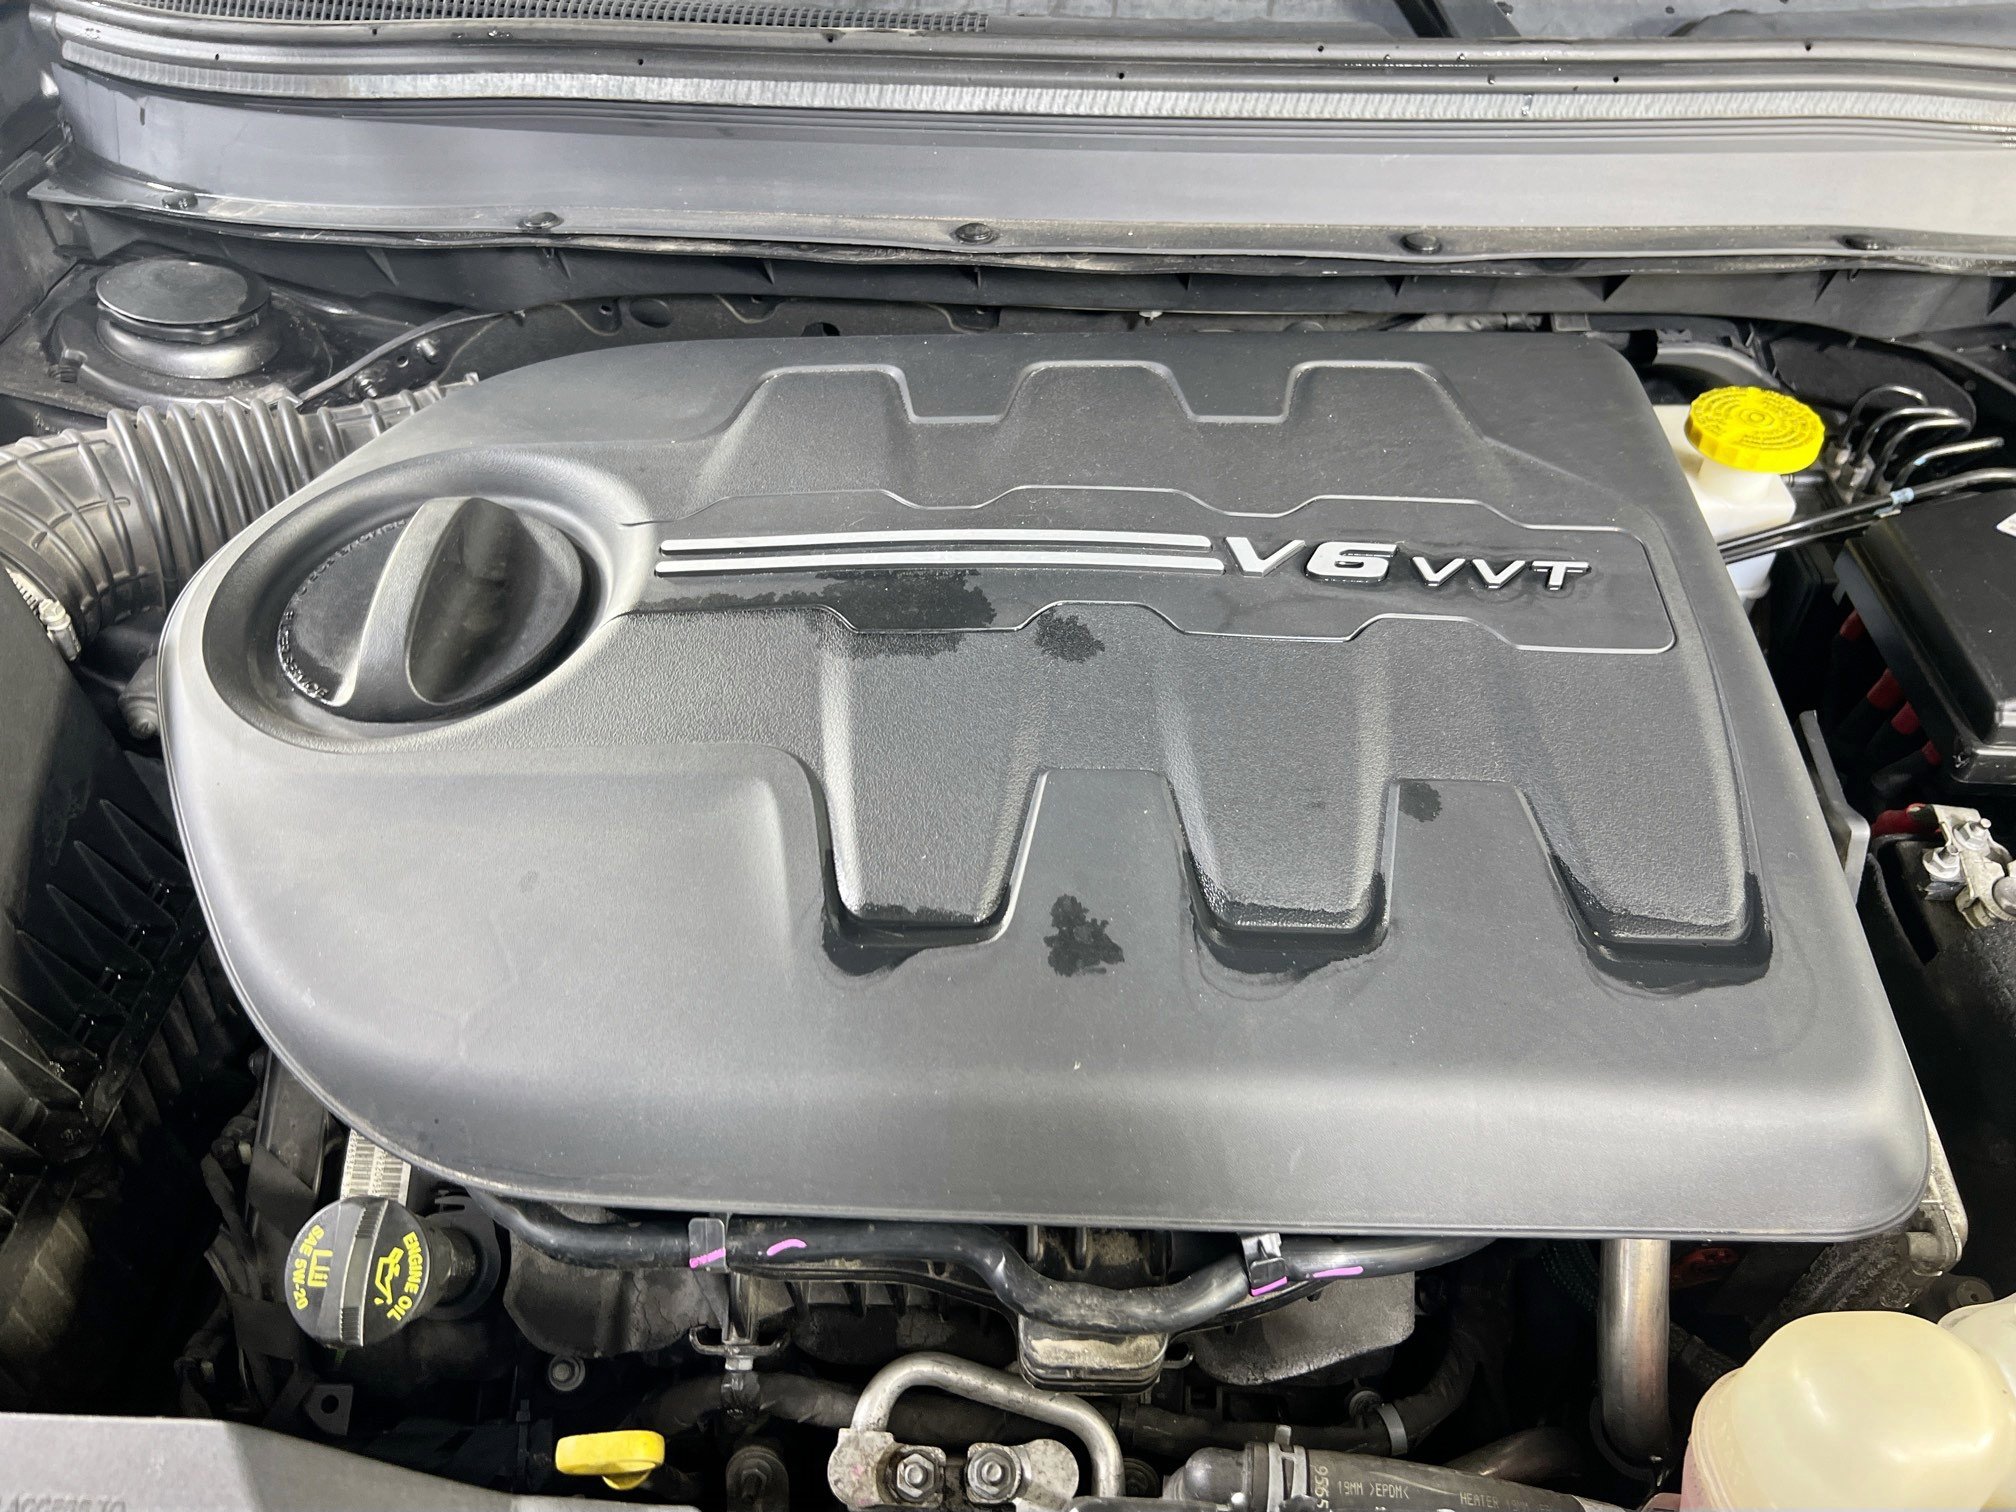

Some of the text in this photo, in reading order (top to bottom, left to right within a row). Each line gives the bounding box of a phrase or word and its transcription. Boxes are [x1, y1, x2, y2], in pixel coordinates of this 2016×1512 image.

[1225, 535, 1591, 591] V6 VVT
[292, 1224, 325, 1310] SAE 5W-20
[386, 1231, 424, 1321] ENGINE OIL
[1337, 1480, 1364, 1496] 19MM
[1459, 1491, 1499, 1509] HEATER
